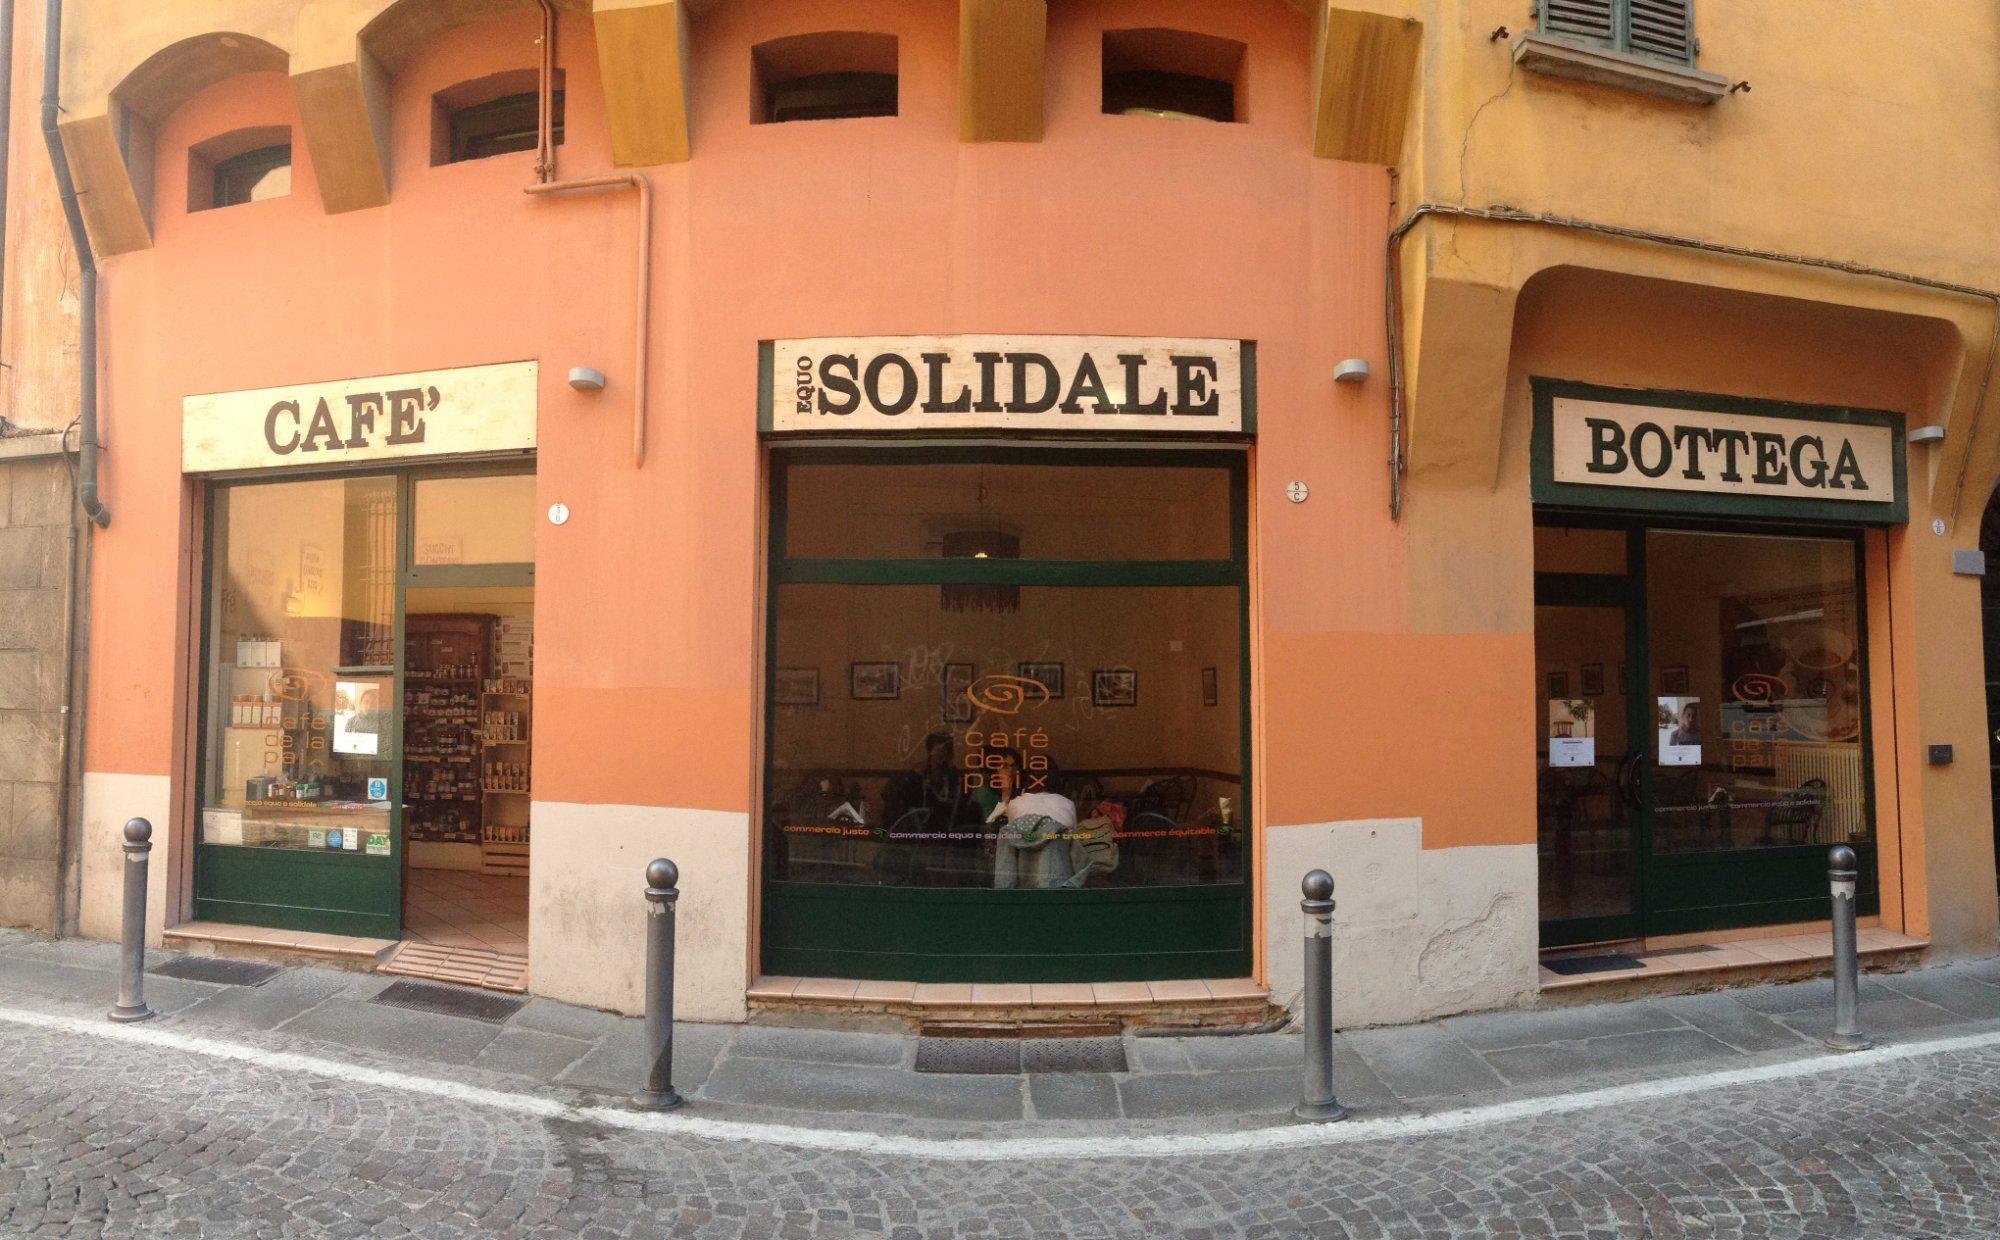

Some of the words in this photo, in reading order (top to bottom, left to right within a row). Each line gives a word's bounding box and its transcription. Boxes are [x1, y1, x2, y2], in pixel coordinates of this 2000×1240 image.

[797, 356, 815, 414] EQUO
[818, 353, 1219, 416] SOLIDALE
[1585, 417, 1869, 490] BOTTEGA
[1293, 492, 1300, 501] C
[1294, 481, 1300, 491] 5
[265, 729, 293, 748] de
[306, 731, 325, 749] la
[964, 726, 1049, 748] café
[964, 748, 1004, 769] de
[1022, 749, 1048, 770] la
[964, 770, 1048, 794] paix
[783, 825, 841, 834] commercio
[842, 827, 870, 836] justo
[889, 830, 947, 839] commercio
[948, 832, 974, 841] equo
[1111, 830, 1167, 838] commerce
[1168, 826, 1216, 837] équitable
